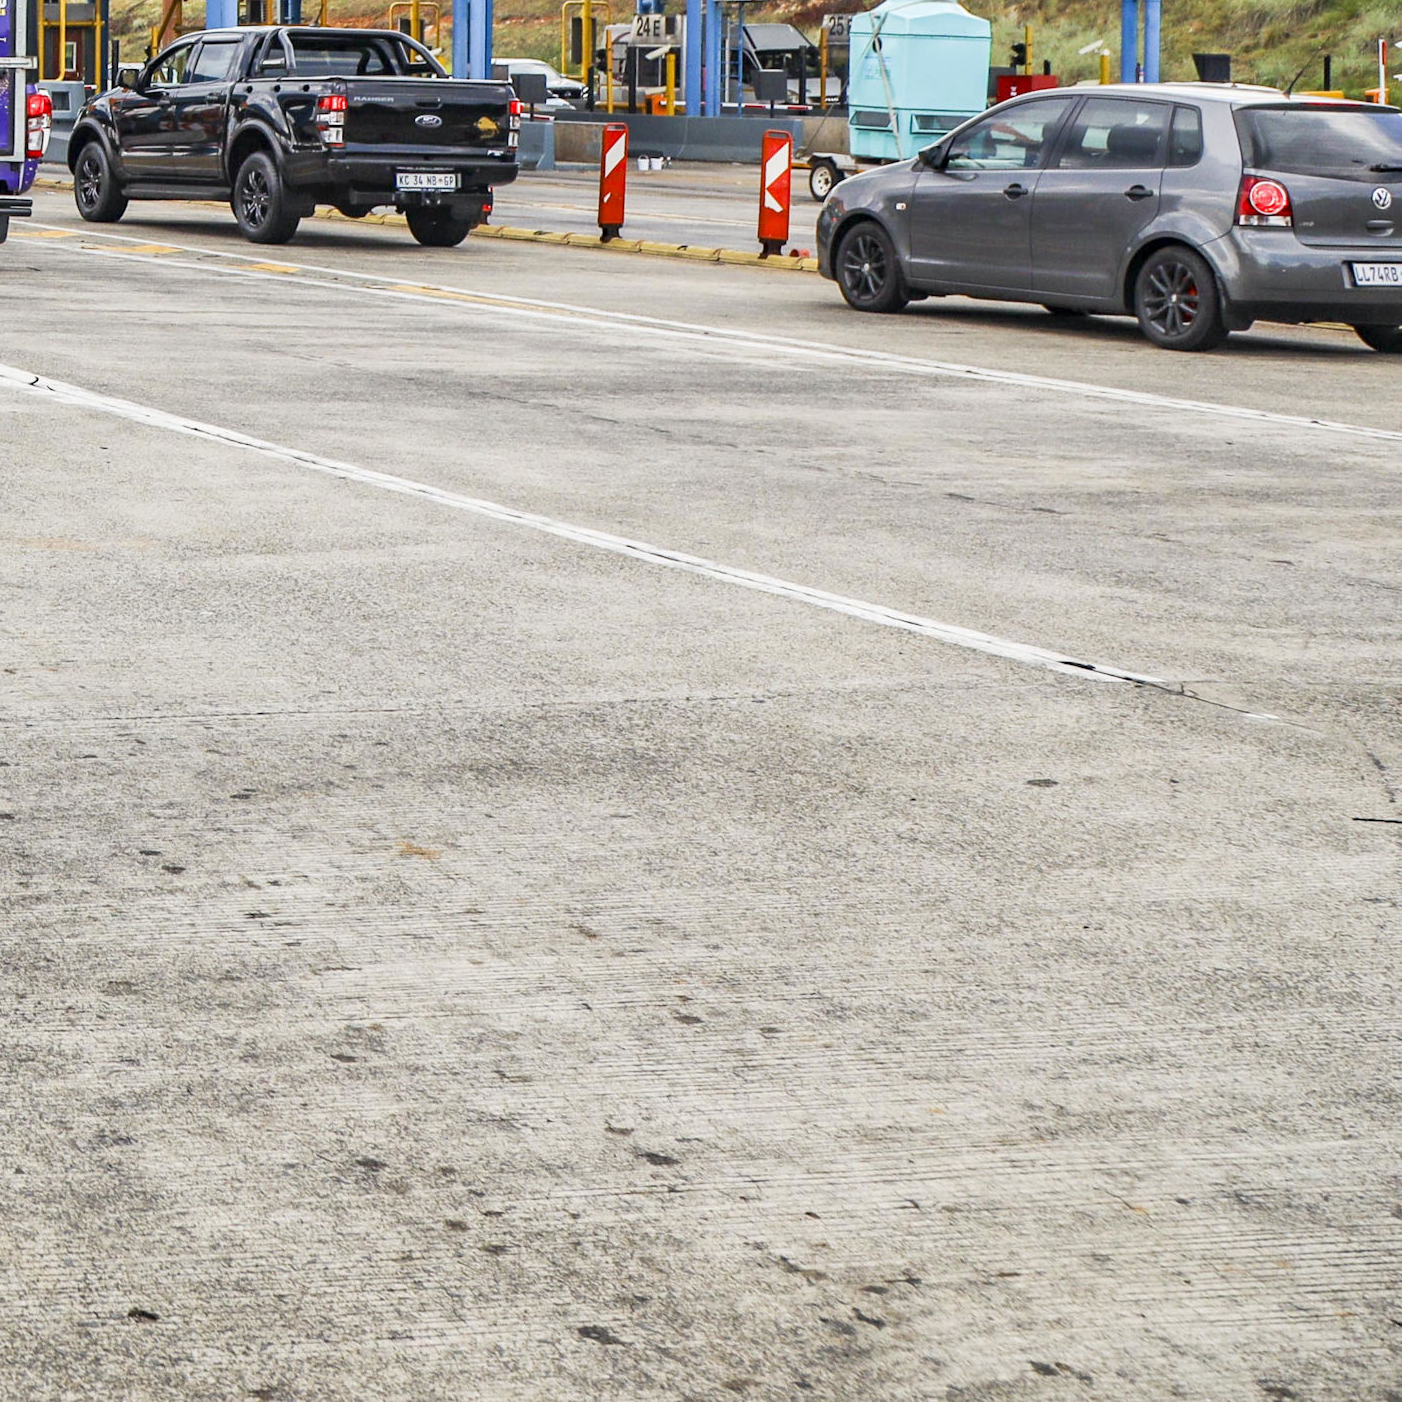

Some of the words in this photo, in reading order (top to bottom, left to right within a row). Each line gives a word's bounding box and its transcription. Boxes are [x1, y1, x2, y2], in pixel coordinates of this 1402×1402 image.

[636, 16, 650, 37] 24
[653, 20, 660, 37] E
[829, 16, 845, 36] 25
[399, 175, 409, 185] KC
[413, 175, 423, 185] 34
[443, 175, 454, 186] GP
[1356, 267, 1398, 282] LL74RB
